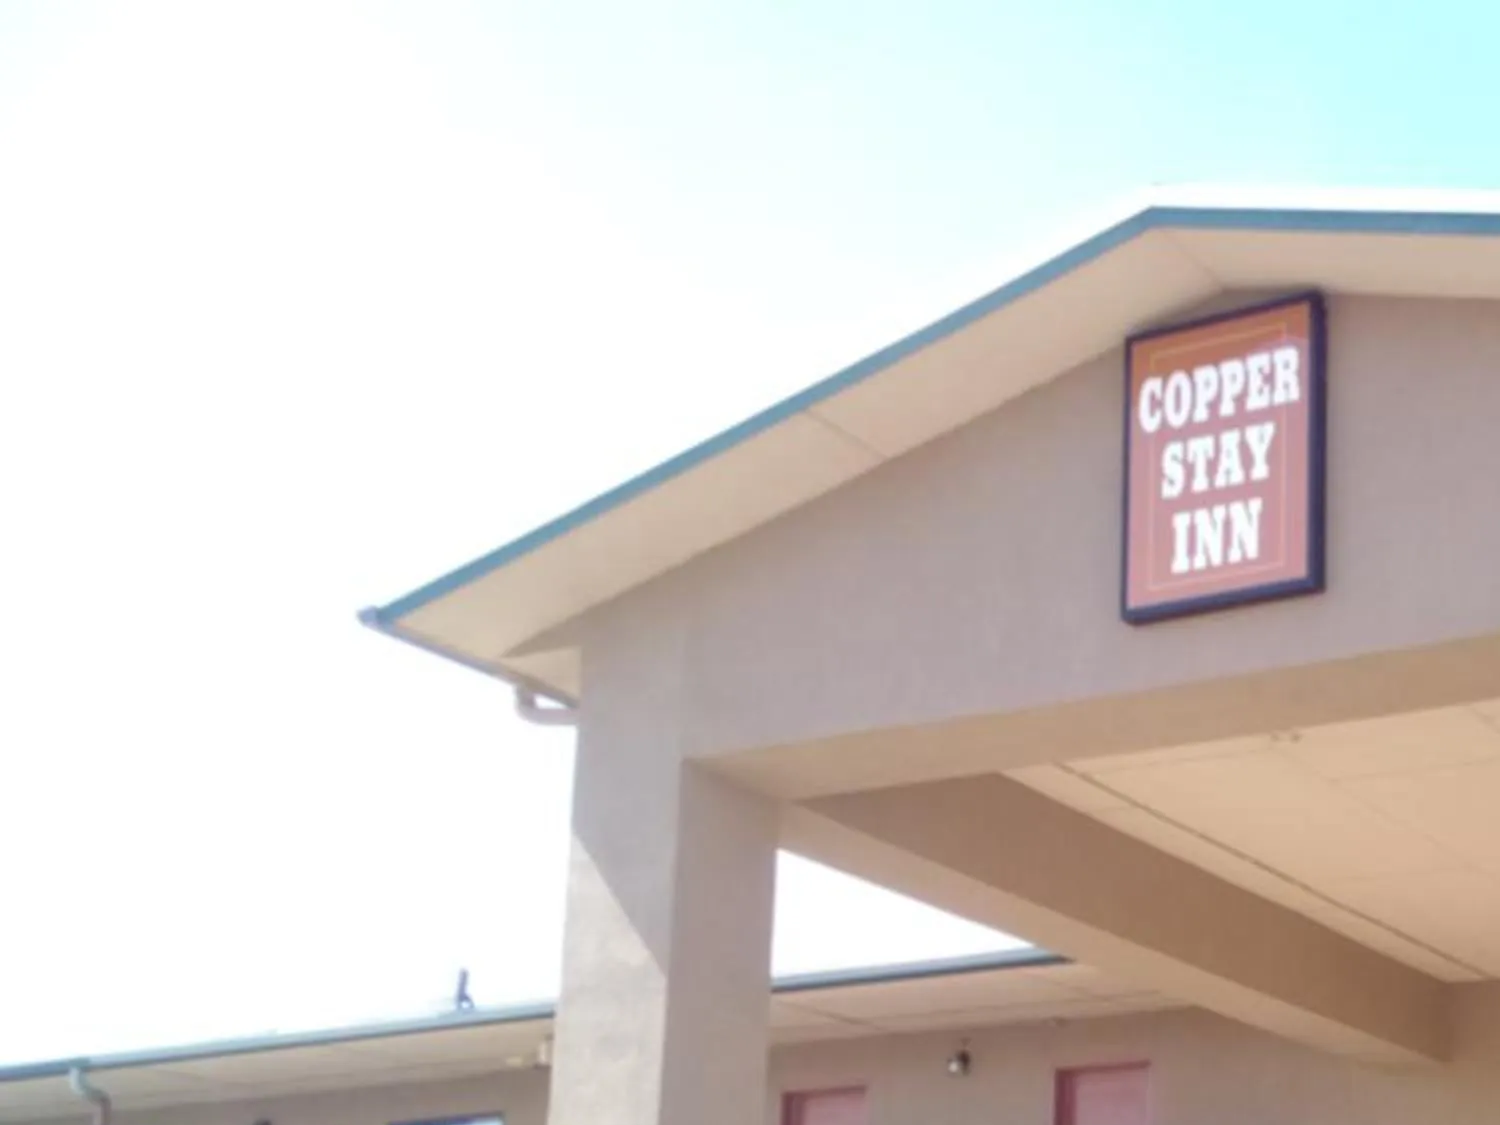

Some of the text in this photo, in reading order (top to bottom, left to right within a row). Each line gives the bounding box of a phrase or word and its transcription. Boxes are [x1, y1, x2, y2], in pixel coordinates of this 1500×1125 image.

[1138, 346, 1301, 433] COPPER
[1161, 422, 1276, 499] STAY
[1171, 497, 1263, 575] INN
